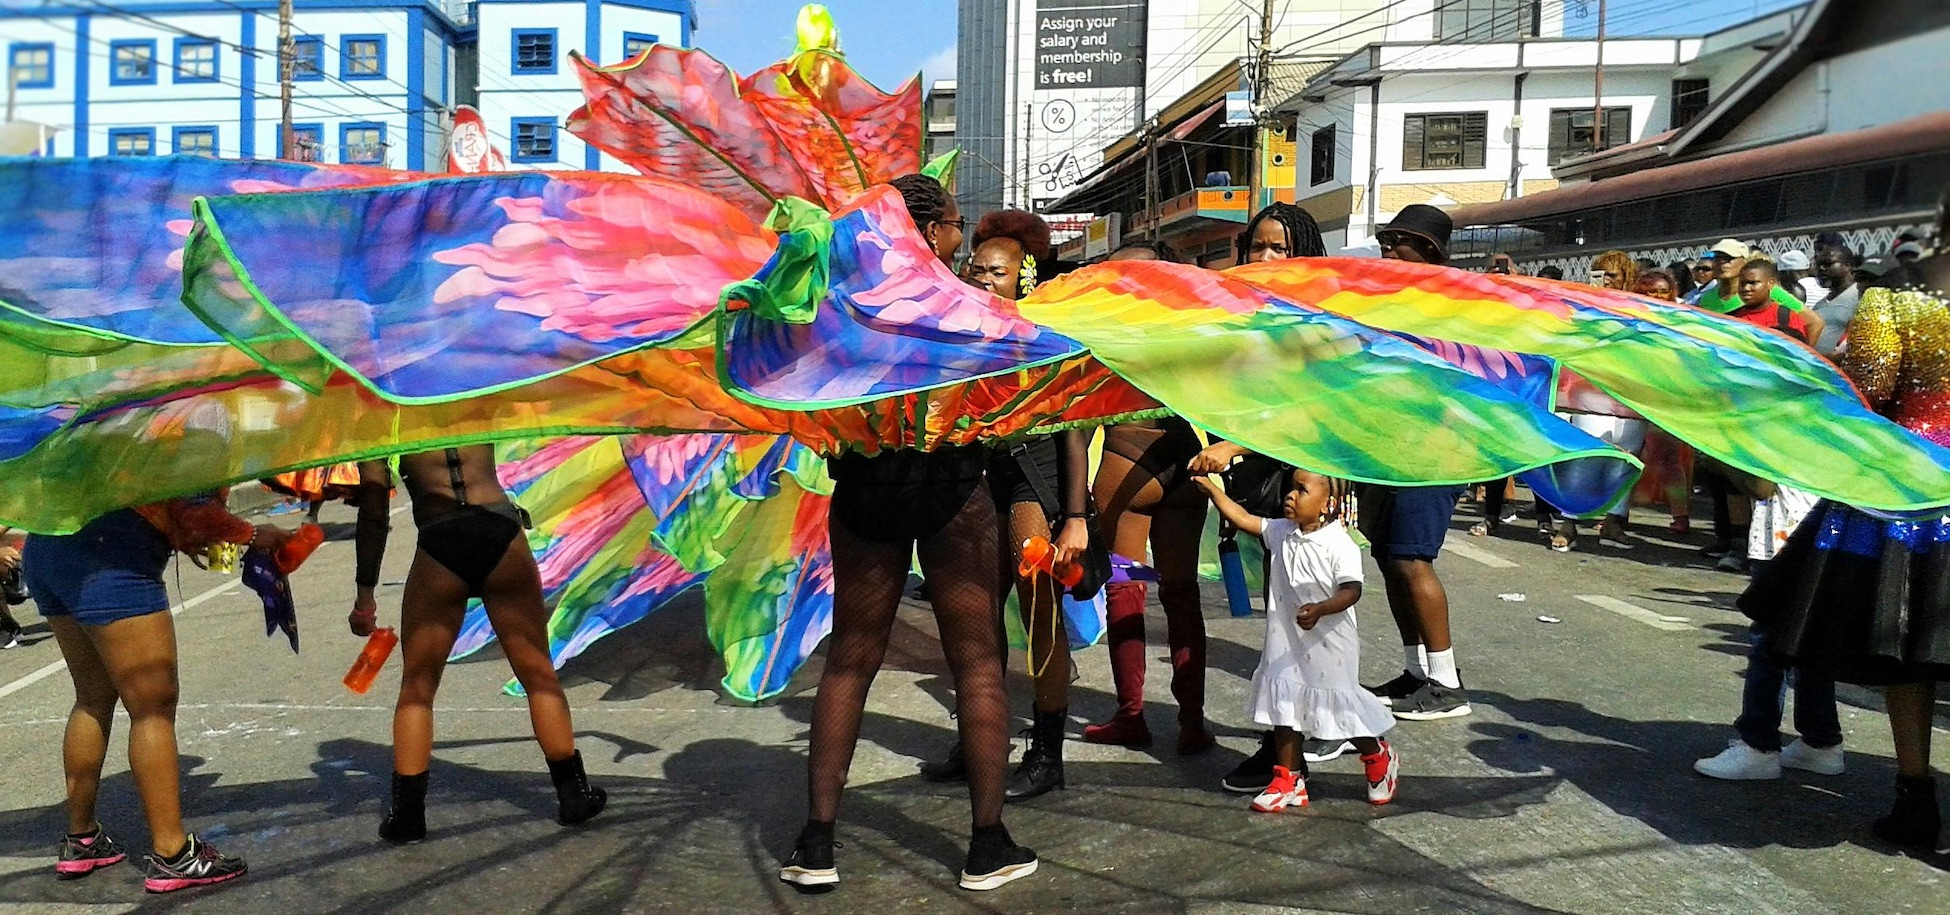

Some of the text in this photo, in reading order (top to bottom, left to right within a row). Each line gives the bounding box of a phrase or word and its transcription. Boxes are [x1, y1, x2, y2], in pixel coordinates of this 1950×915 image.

[1040, 16, 1118, 32] Assign your
[1040, 31, 1108, 50] salary and
[1040, 49, 1123, 65] membership
[1040, 68, 1092, 84] is free!
